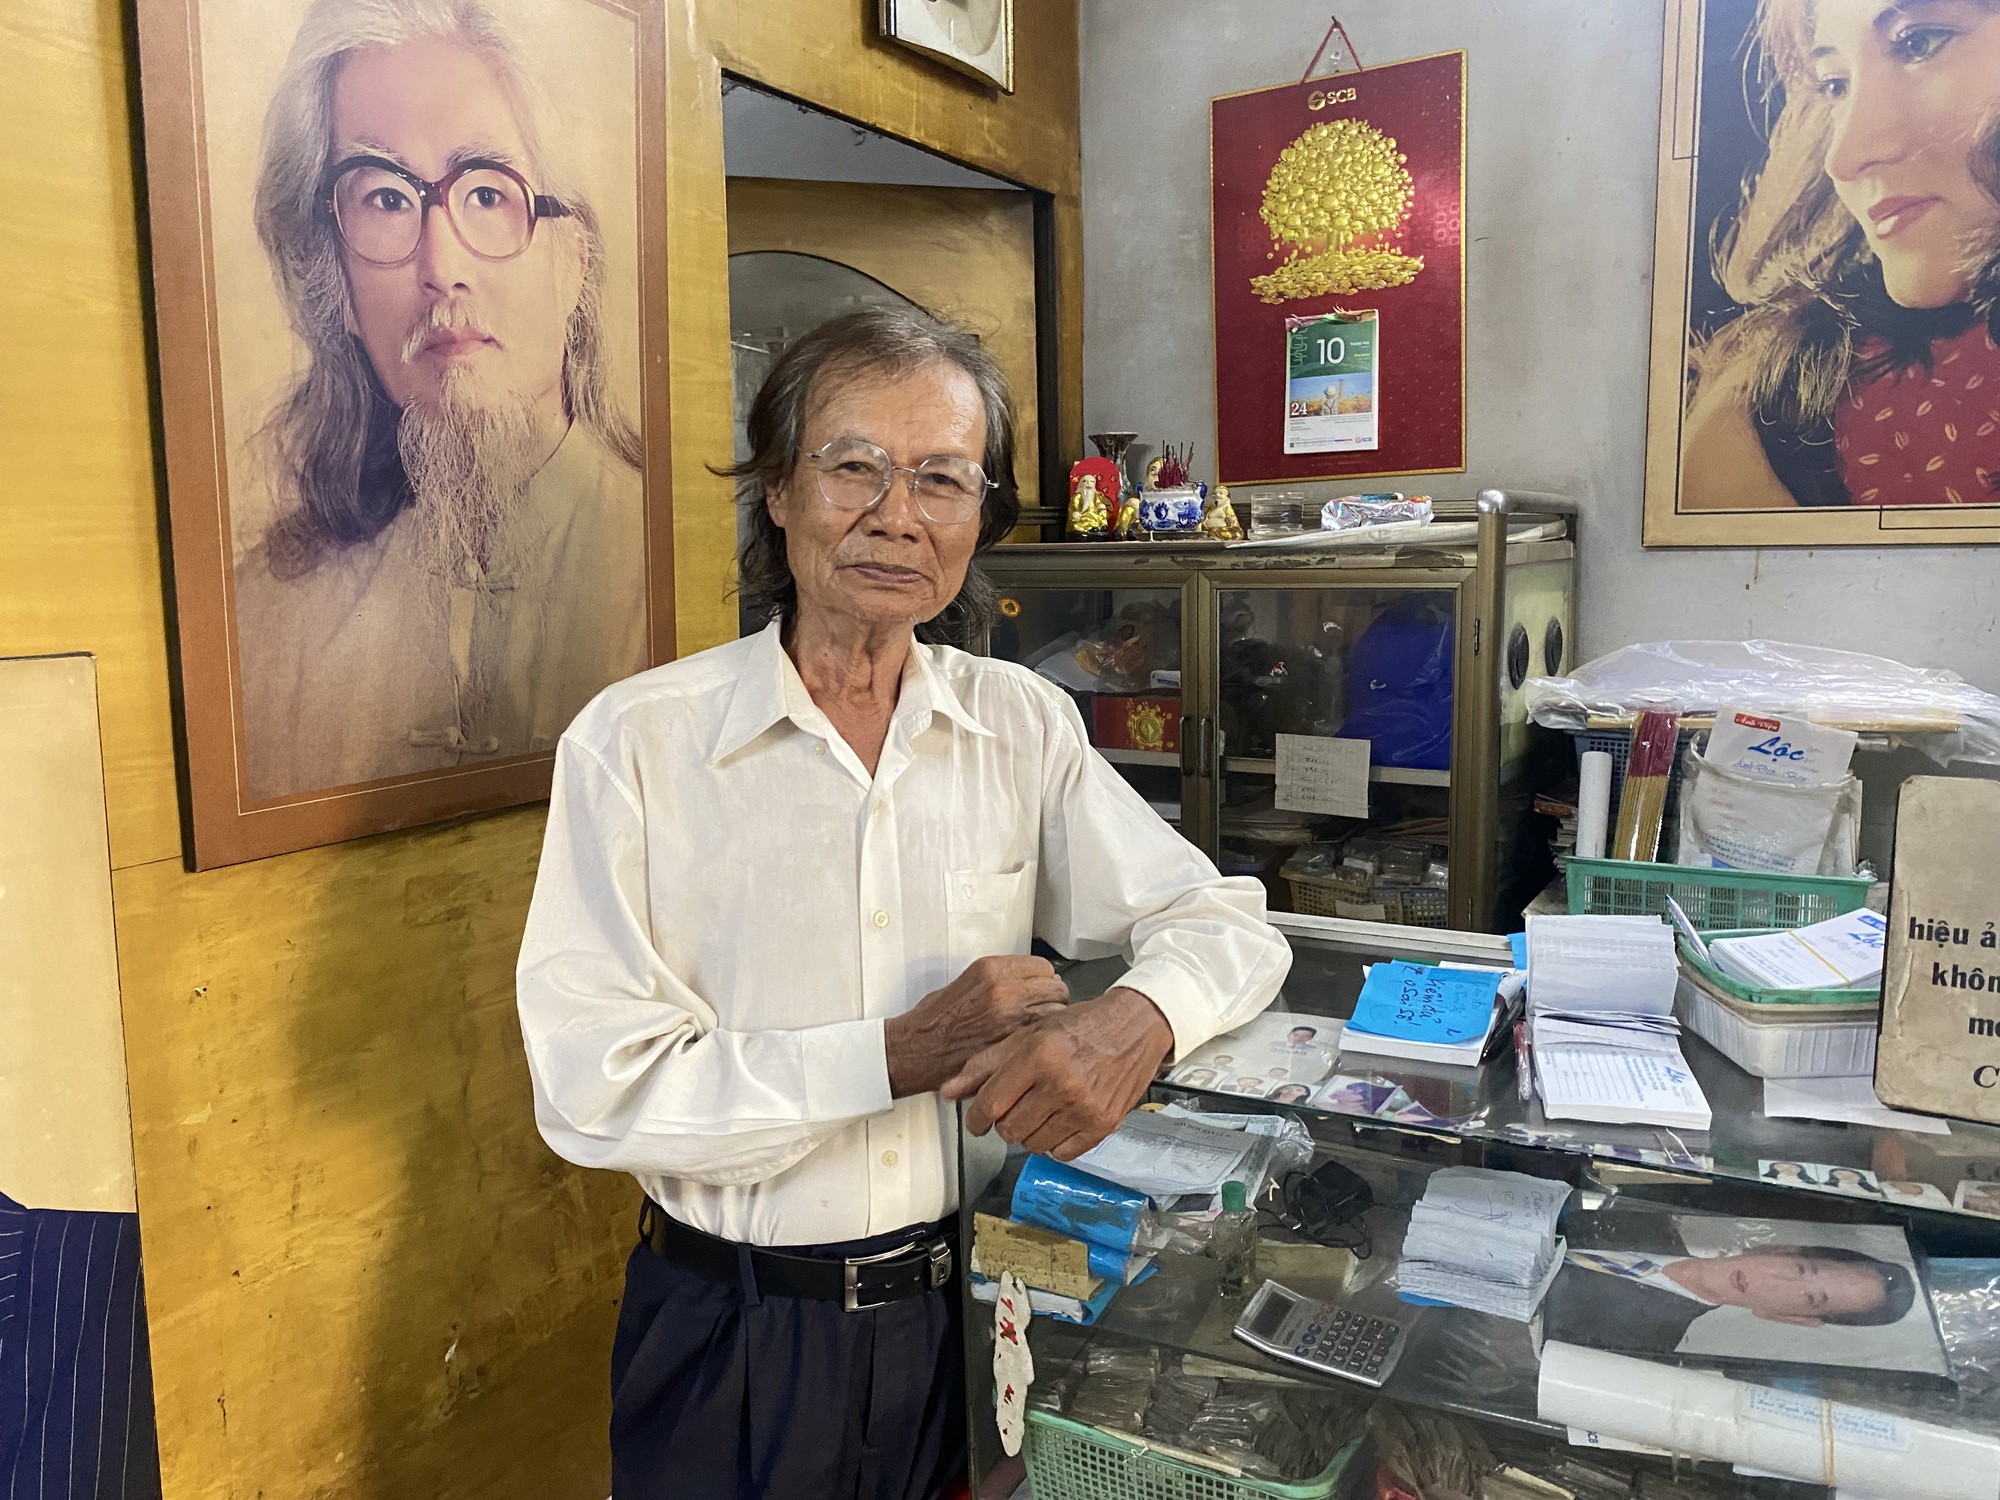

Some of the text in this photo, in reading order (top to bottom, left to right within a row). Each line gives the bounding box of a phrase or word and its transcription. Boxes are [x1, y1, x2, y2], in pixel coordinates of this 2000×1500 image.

[1327, 88, 1357, 104] SCB
[1317, 337, 1345, 365] 10
[1291, 402, 1308, 416] 24
[1747, 736, 1804, 762] Lộc
[1908, 916, 1969, 948] hiệu
